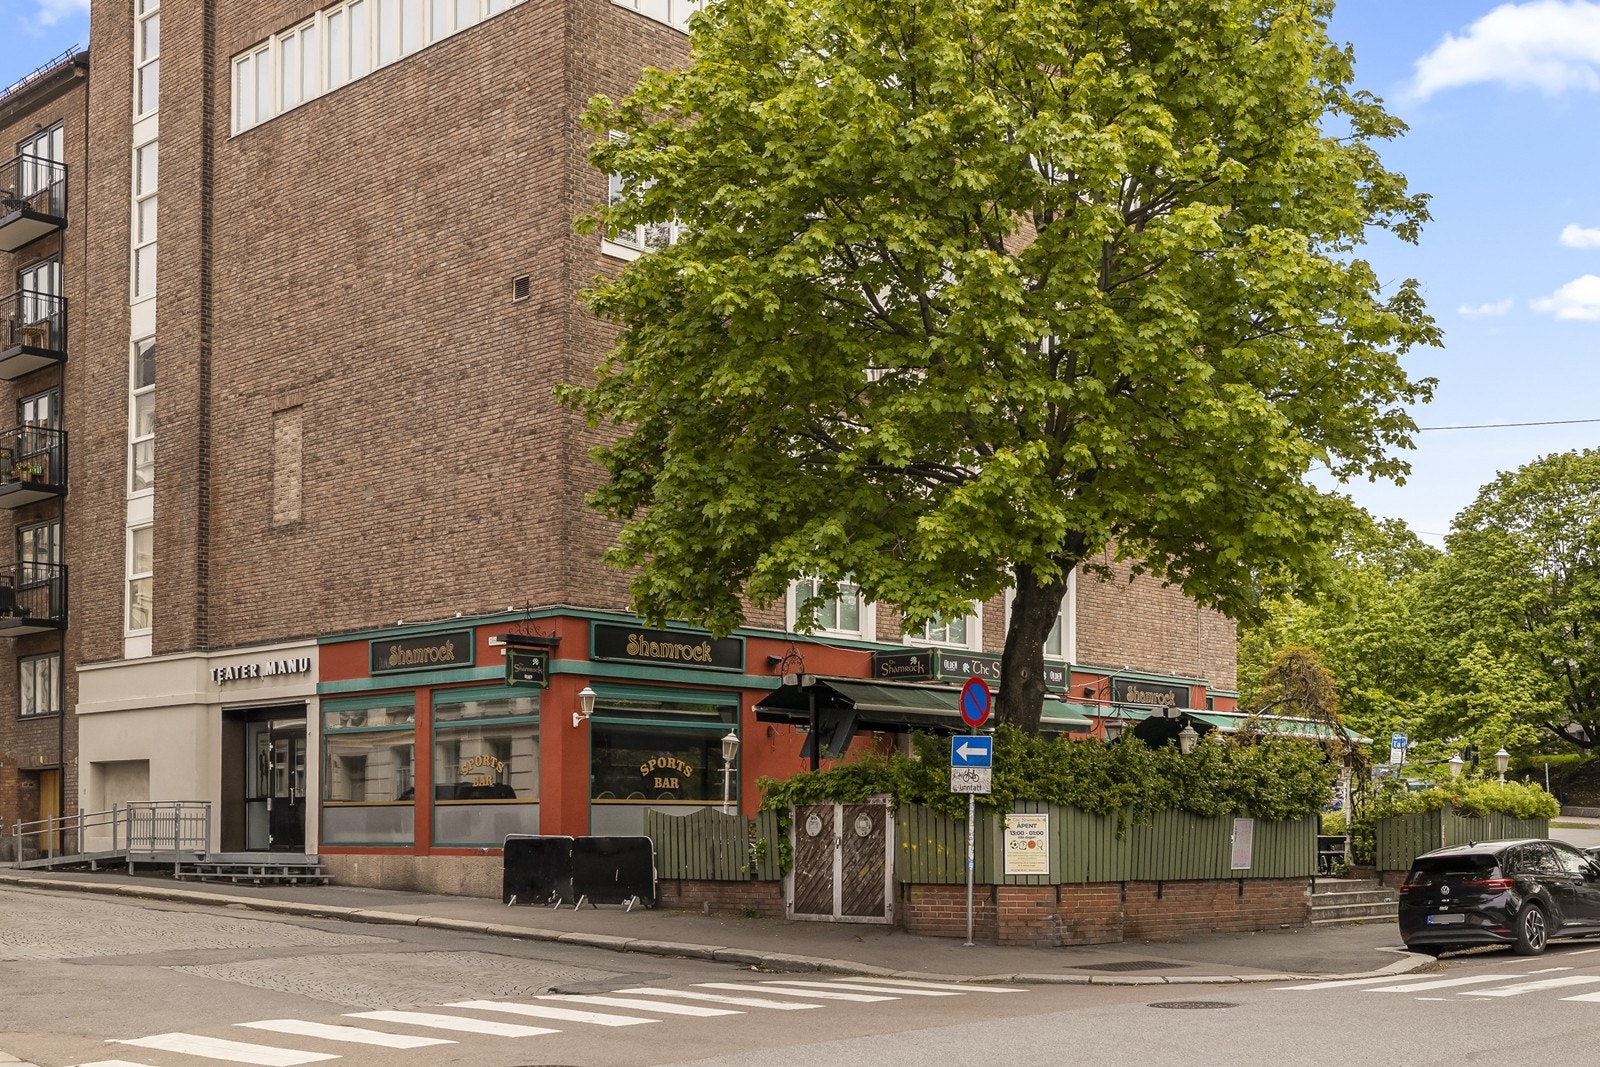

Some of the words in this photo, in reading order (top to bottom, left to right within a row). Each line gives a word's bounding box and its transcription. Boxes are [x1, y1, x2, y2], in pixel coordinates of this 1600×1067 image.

[388, 639, 455, 667] Shamrock
[626, 633, 713, 663] Shamrock
[209, 664, 260, 686] TEATER
[265, 657, 311, 676] MANU
[881, 661, 925, 677] Shamrock
[972, 660, 990, 675] The
[992, 661, 1000, 679] S
[1126, 685, 1176, 706] Shamrock
[461, 754, 505, 777] SPORTS
[640, 756, 693, 778] SPORTS
[472, 774, 495, 787] BAR
[653, 777, 680, 789] BAR
[1016, 821, 1037, 829] ÅPENT
